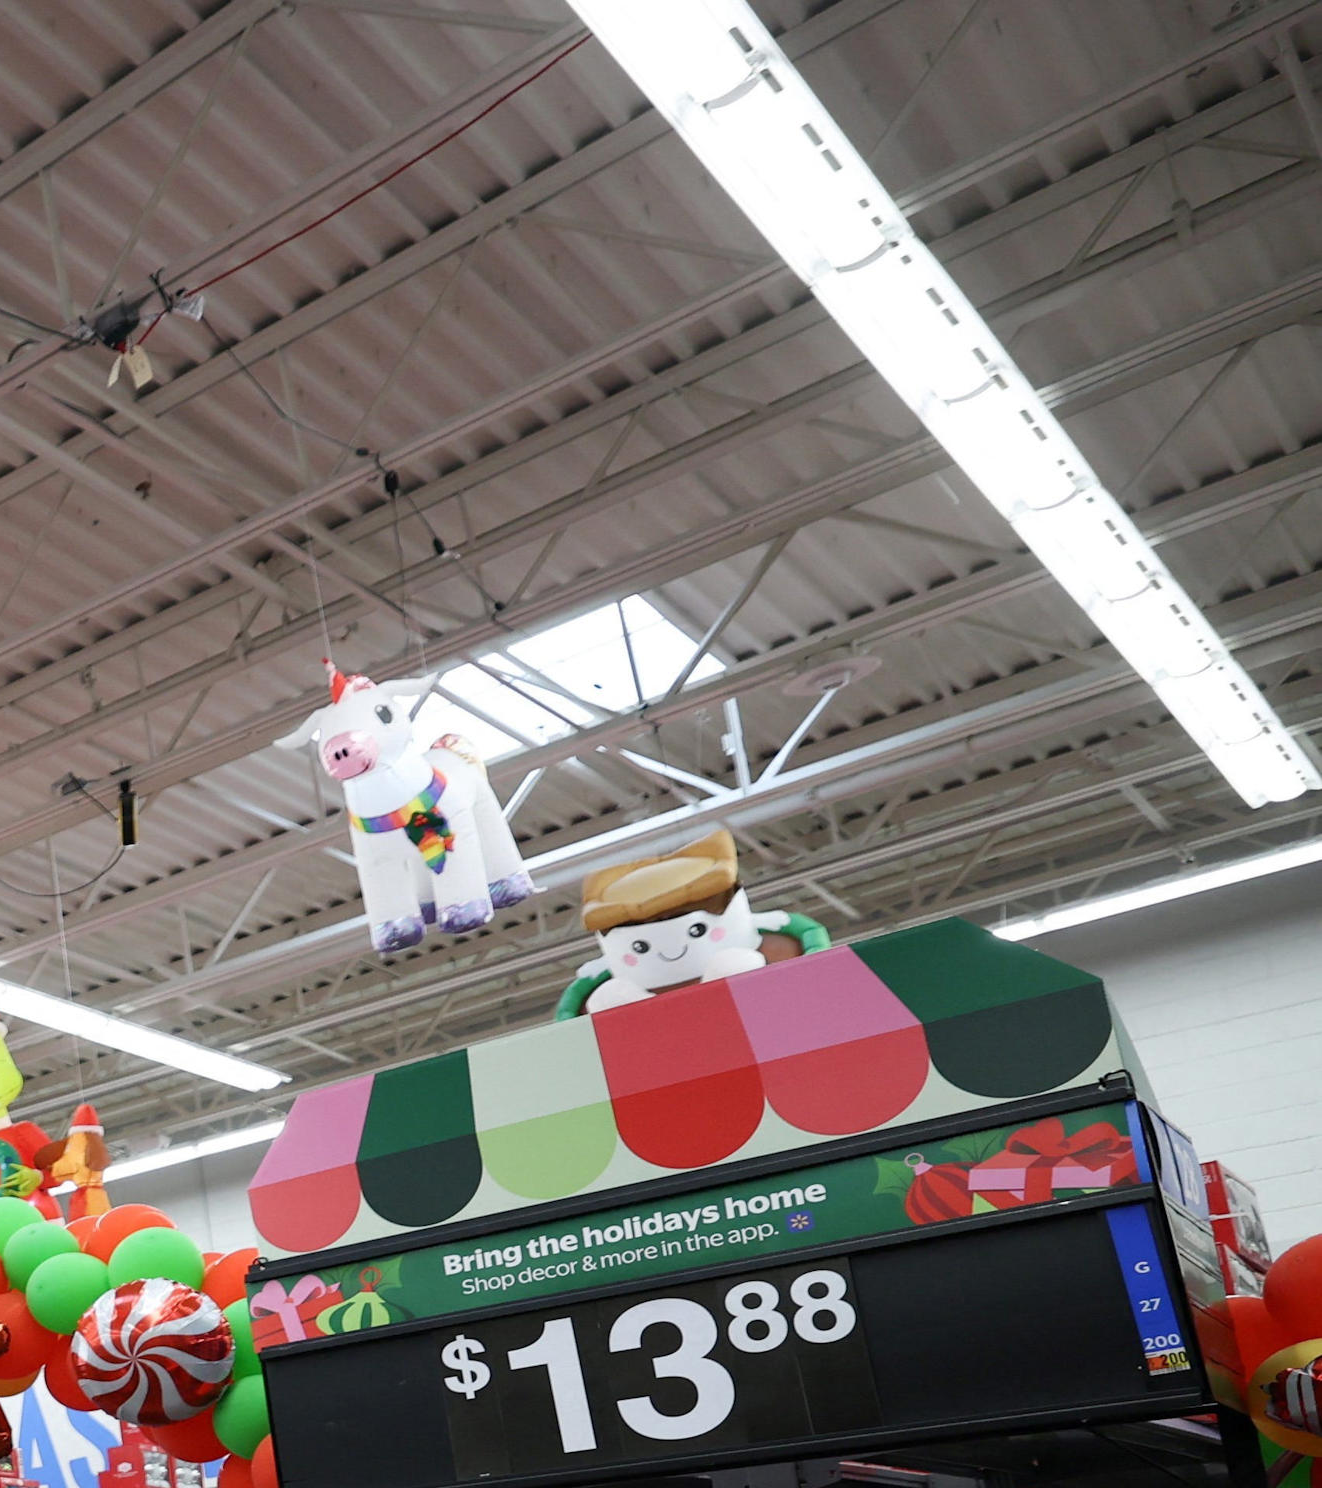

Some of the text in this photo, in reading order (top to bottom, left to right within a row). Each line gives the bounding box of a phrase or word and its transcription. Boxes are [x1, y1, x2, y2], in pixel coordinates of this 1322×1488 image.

[442, 1183, 826, 1275] Bring the holidays home
[461, 1224, 779, 1296] Shop decor & more in the app.
[1134, 1262, 1151, 1273] G
[1140, 1298, 1161, 1312] 27
[1143, 1333, 1181, 1350] 200
[1159, 1351, 1188, 1367] 200
